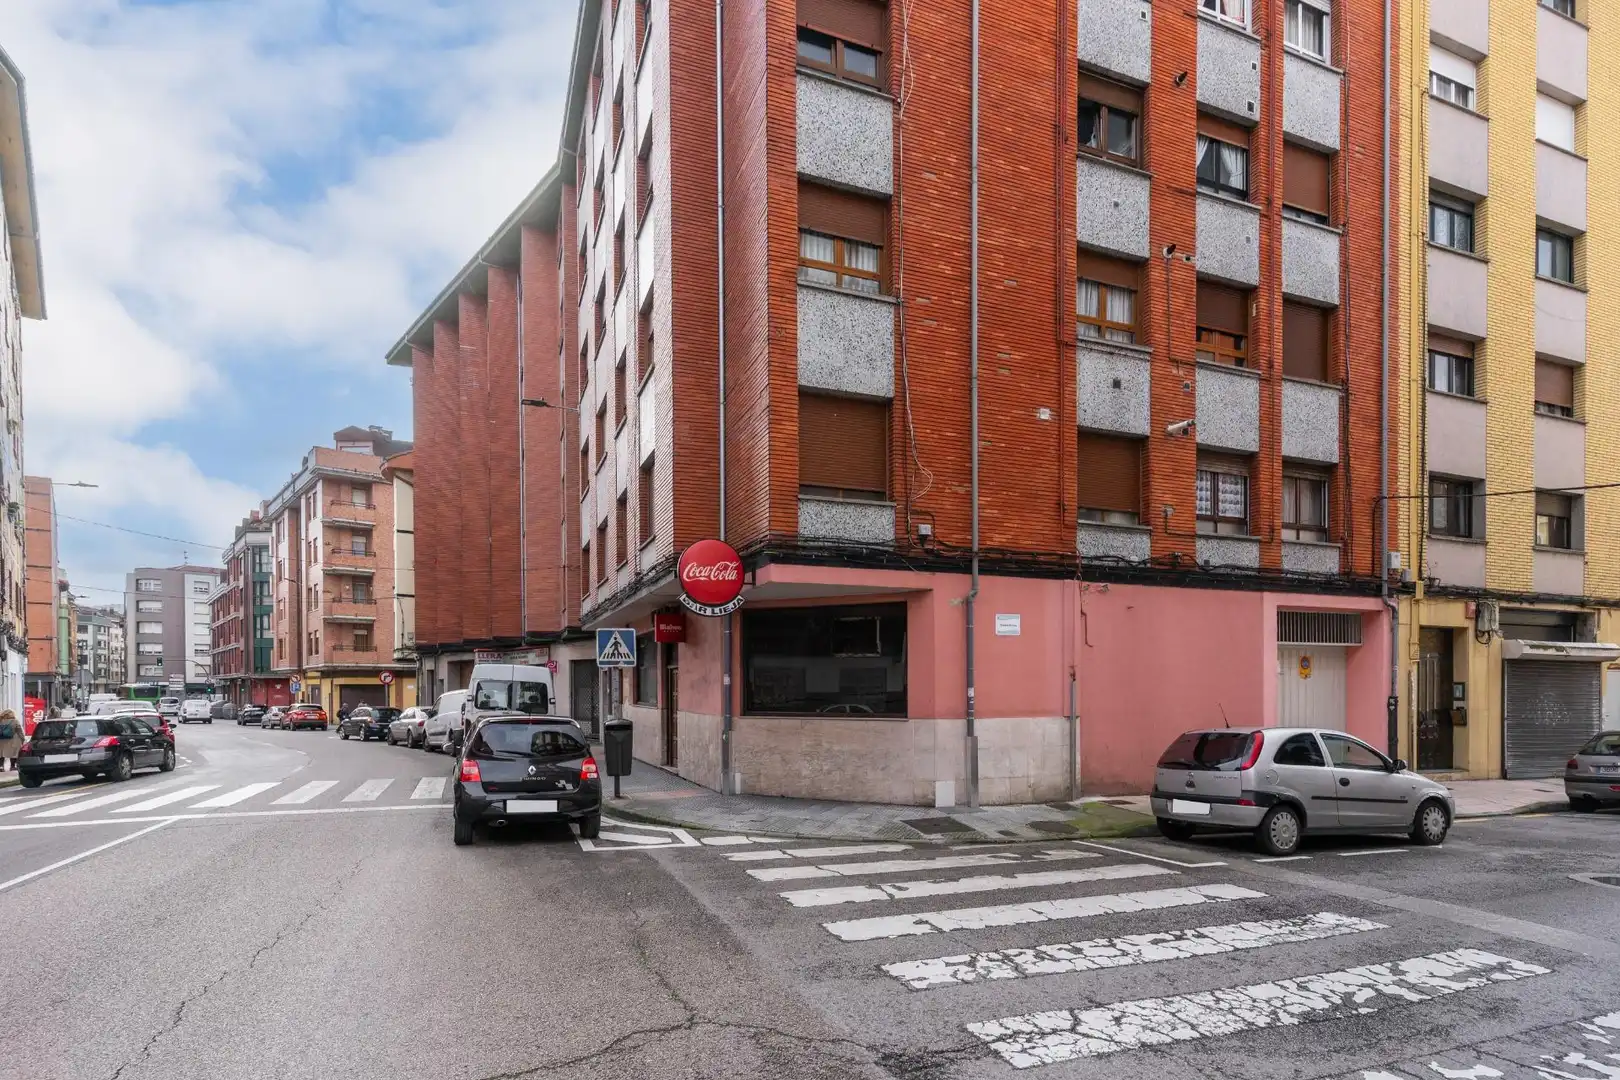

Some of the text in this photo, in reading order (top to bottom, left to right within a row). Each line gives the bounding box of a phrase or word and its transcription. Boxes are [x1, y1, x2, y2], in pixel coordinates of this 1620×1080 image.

[682, 561, 740, 582] Coca-Cola
[682, 596, 744, 615] BAR LIEJA
